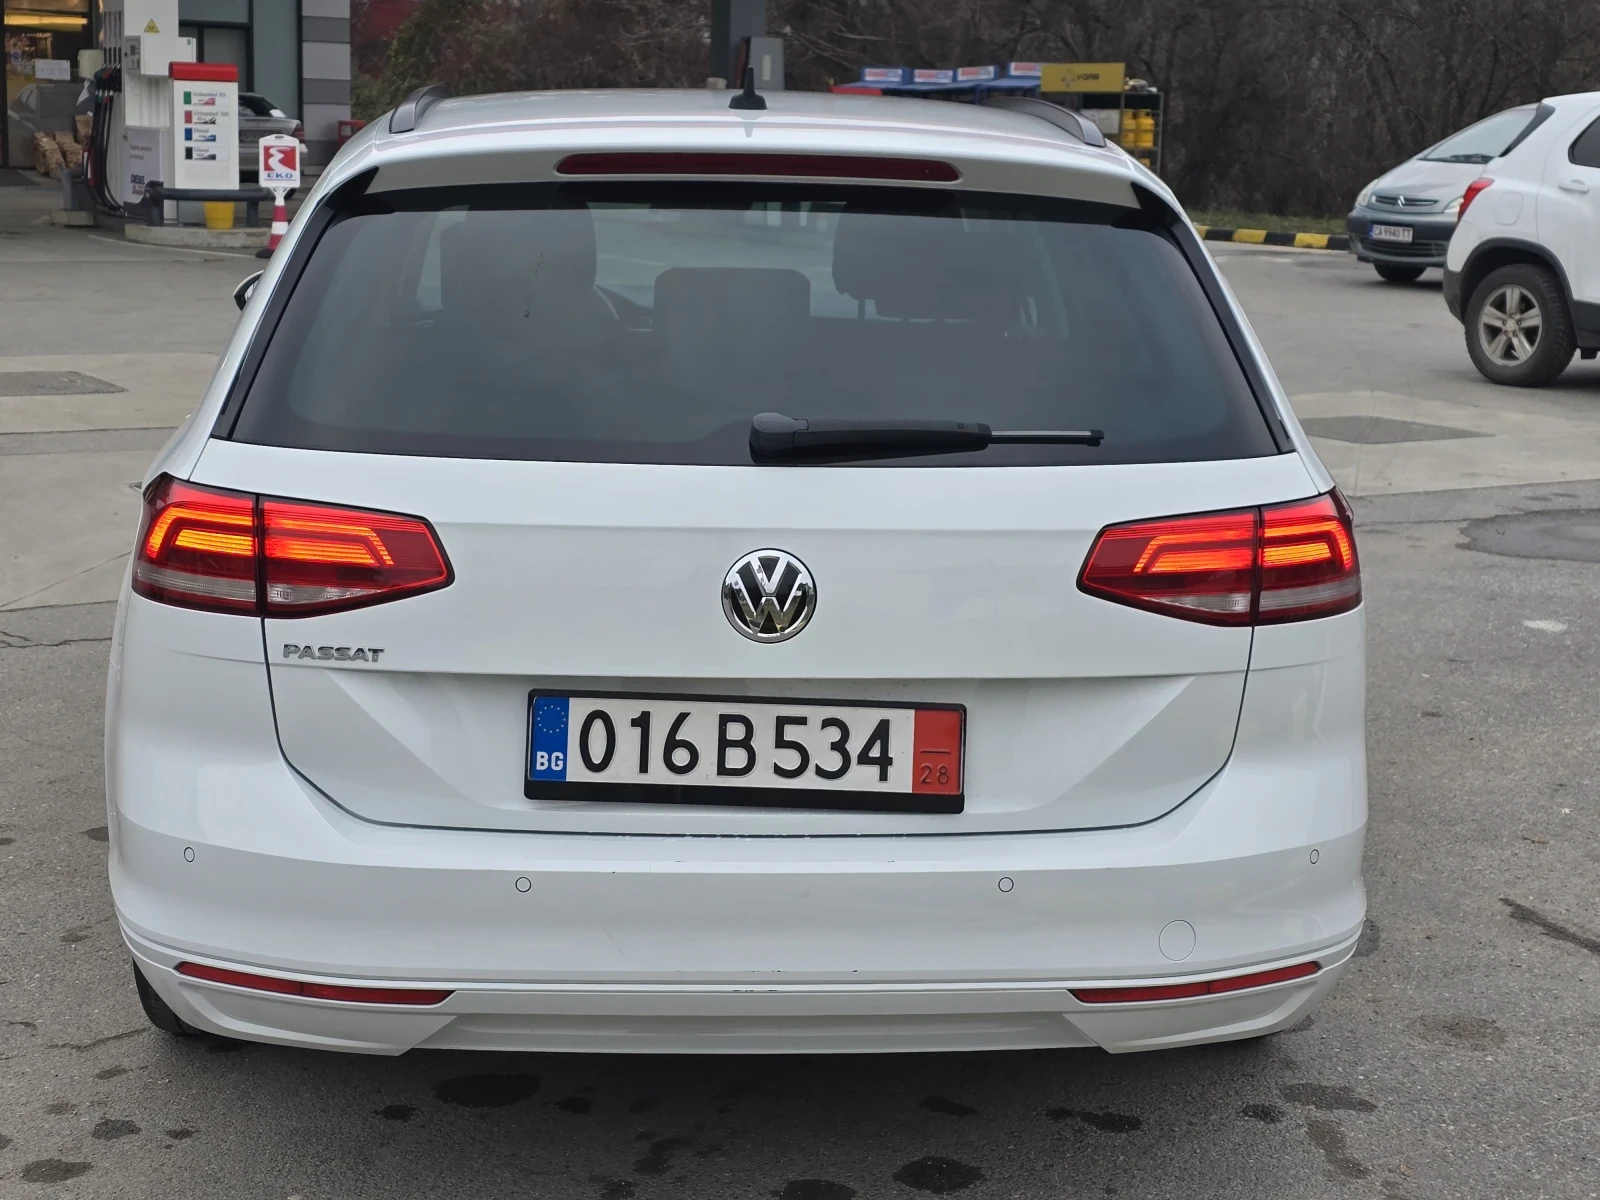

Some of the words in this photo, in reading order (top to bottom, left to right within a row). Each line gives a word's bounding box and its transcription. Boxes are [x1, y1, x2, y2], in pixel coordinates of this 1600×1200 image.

[282, 643, 385, 663] PASSAT
[536, 750, 564, 772] BG
[919, 764, 950, 786] 28
